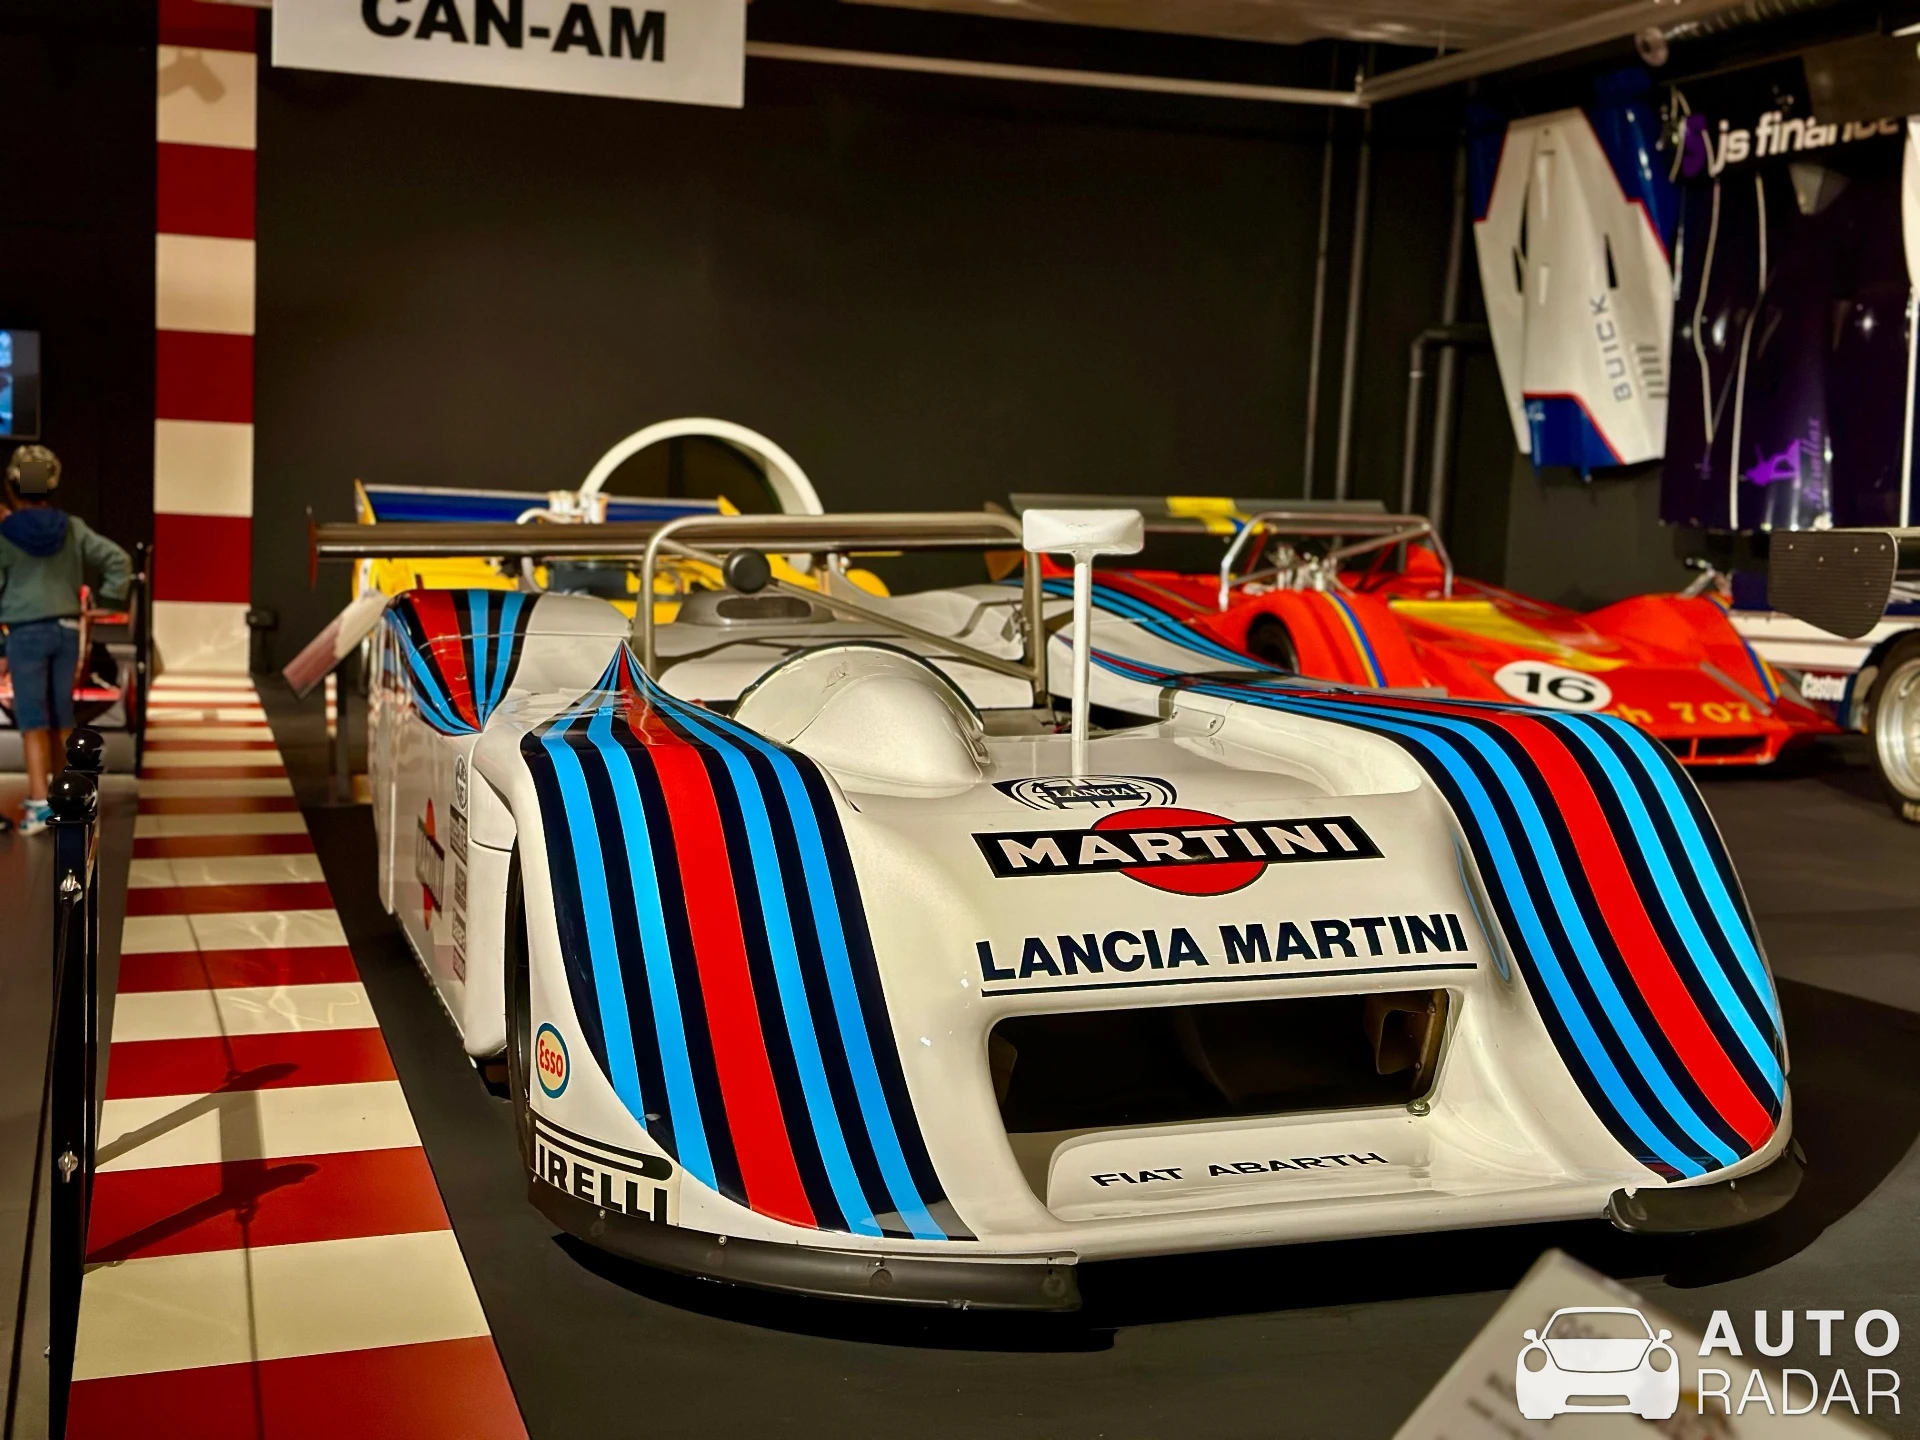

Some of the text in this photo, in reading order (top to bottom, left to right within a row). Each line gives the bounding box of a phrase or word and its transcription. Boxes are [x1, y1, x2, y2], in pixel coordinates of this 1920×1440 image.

[361, 0, 667, 63] CAN-AM
[1589, 294, 1633, 402] BUICK
[1513, 670, 1597, 704] 16
[1667, 701, 1752, 724] 707
[1051, 787, 1134, 799] LANCIA
[997, 822, 1359, 869] MARTINI
[975, 913, 1470, 982] LANCIA MARTINI
[1090, 1151, 1390, 1187] FIAT ABARTH
